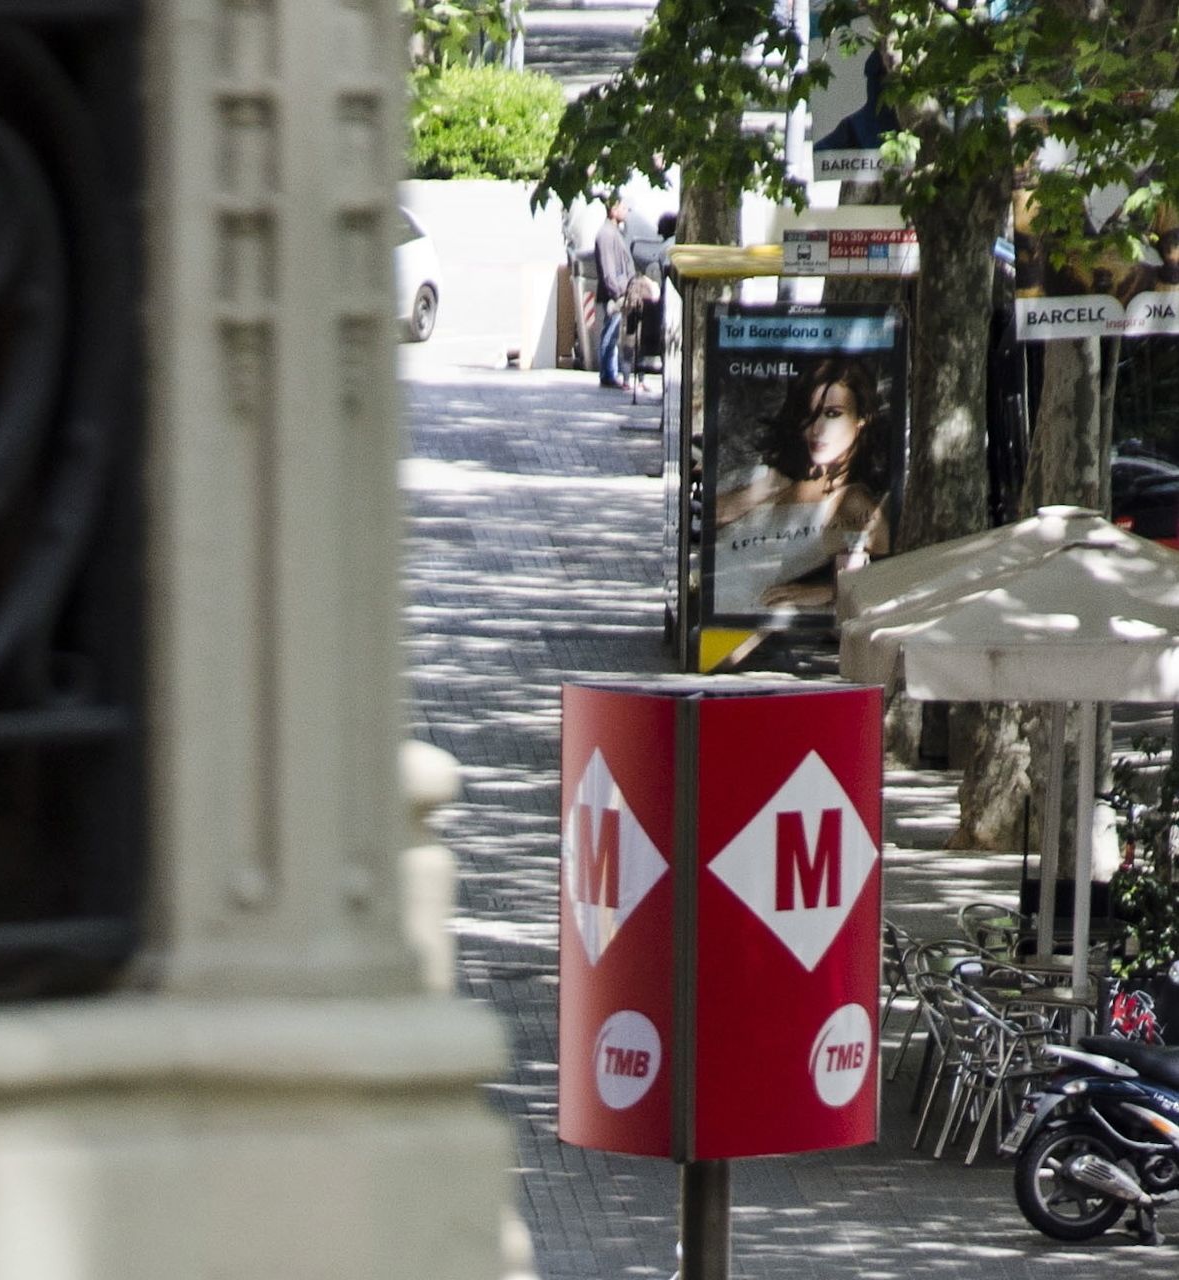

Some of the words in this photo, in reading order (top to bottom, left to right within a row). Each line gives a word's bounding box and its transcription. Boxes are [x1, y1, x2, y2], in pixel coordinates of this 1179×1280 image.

[725, 325, 745, 338] Tot
[749, 325, 819, 338] Barcelona
[823, 328, 832, 338] a
[729, 362, 799, 377] CHANEL
[577, 803, 620, 909] M
[775, 807, 842, 911] M
[605, 1046, 651, 1078] TMB
[826, 1041, 864, 1073] TMB
